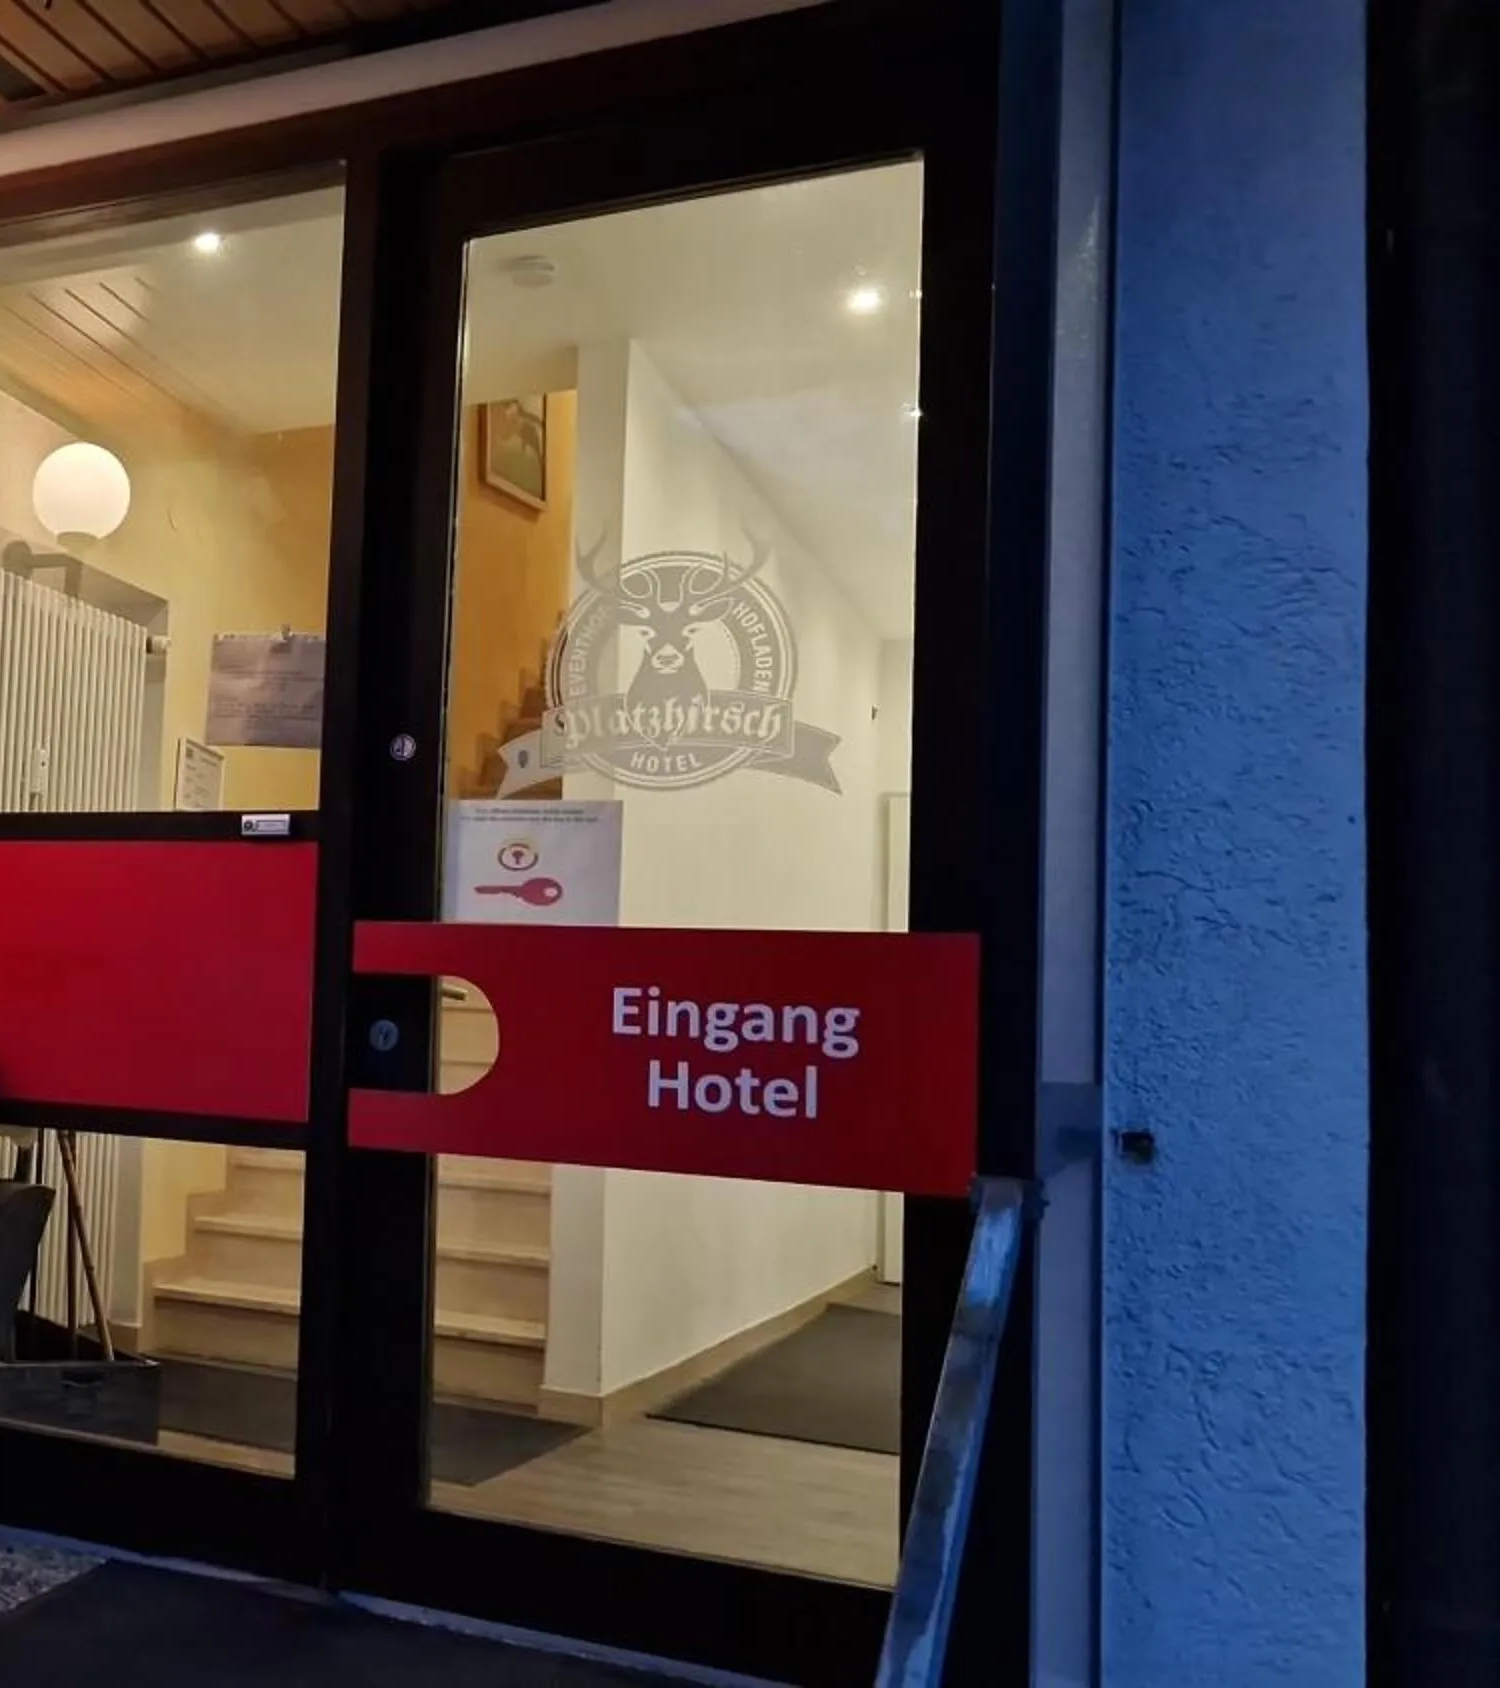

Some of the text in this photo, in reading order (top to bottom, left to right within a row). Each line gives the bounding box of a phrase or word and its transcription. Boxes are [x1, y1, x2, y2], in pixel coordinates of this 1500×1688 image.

[731, 601, 773, 694] HOFLADEN
[555, 694, 786, 749] Platzhirsch
[629, 752, 703, 774] HOTEL
[612, 985, 861, 1059] Eingang
[647, 1059, 818, 1119] Hotel
